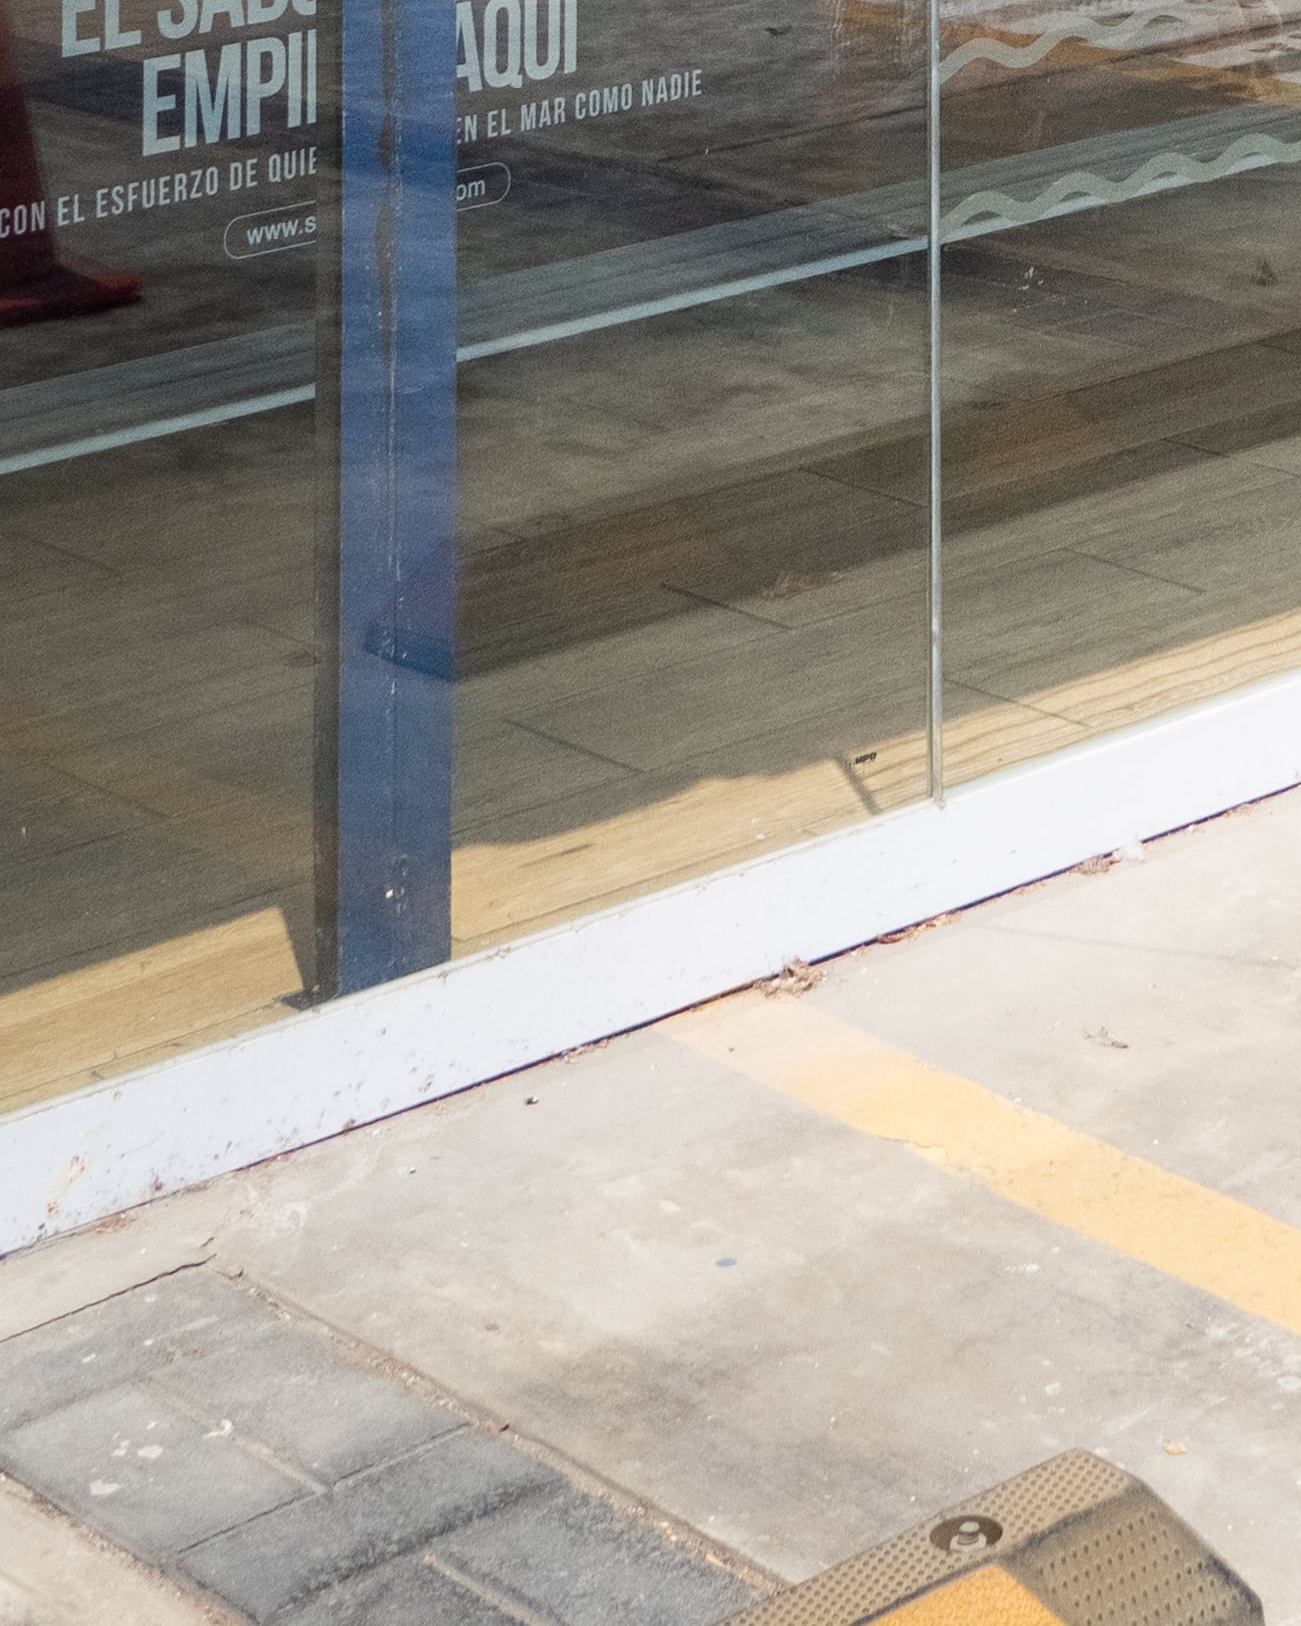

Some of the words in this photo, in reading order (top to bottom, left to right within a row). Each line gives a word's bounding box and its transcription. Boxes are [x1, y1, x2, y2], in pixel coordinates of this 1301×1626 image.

[0, 201, 45, 238] CON
[57, 194, 84, 226] EL
[96, 167, 219, 218] ESFUERZO
[230, 159, 258, 191] DE
[487, 109, 511, 138] EL
[521, 97, 565, 131] MAR
[575, 84, 632, 119] COMO
[641, 69, 702, 106] NADIE
